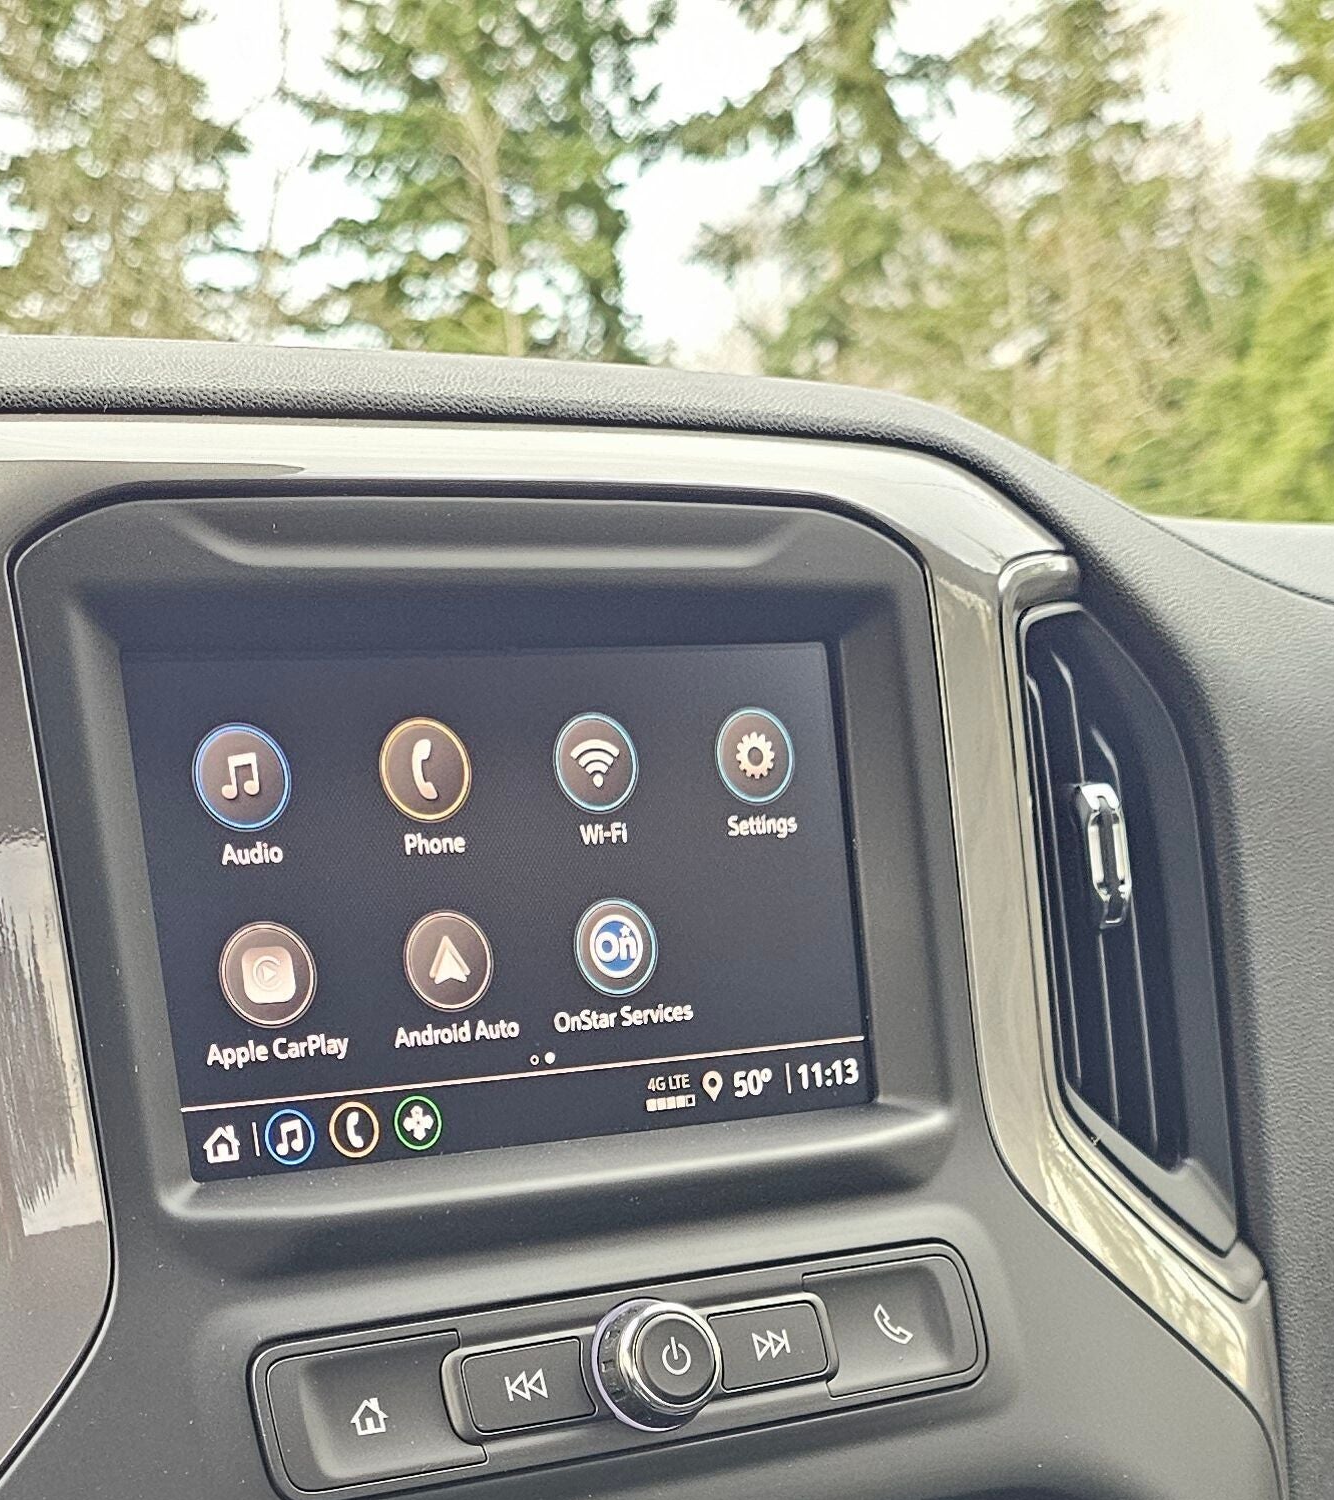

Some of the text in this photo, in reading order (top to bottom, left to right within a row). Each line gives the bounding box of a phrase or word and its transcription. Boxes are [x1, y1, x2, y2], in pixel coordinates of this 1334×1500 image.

[579, 821, 628, 846] Wi-Fi
[727, 814, 798, 839] Settings
[221, 841, 284, 866] Audio
[403, 832, 466, 856] Phone
[553, 1003, 694, 1033] OnStar Services
[394, 1019, 520, 1049] Android Auto
[206, 1033, 349, 1071] Apple CarPlay
[647, 1073, 691, 1092] 4G LTE
[797, 1057, 859, 1090] 11:13
